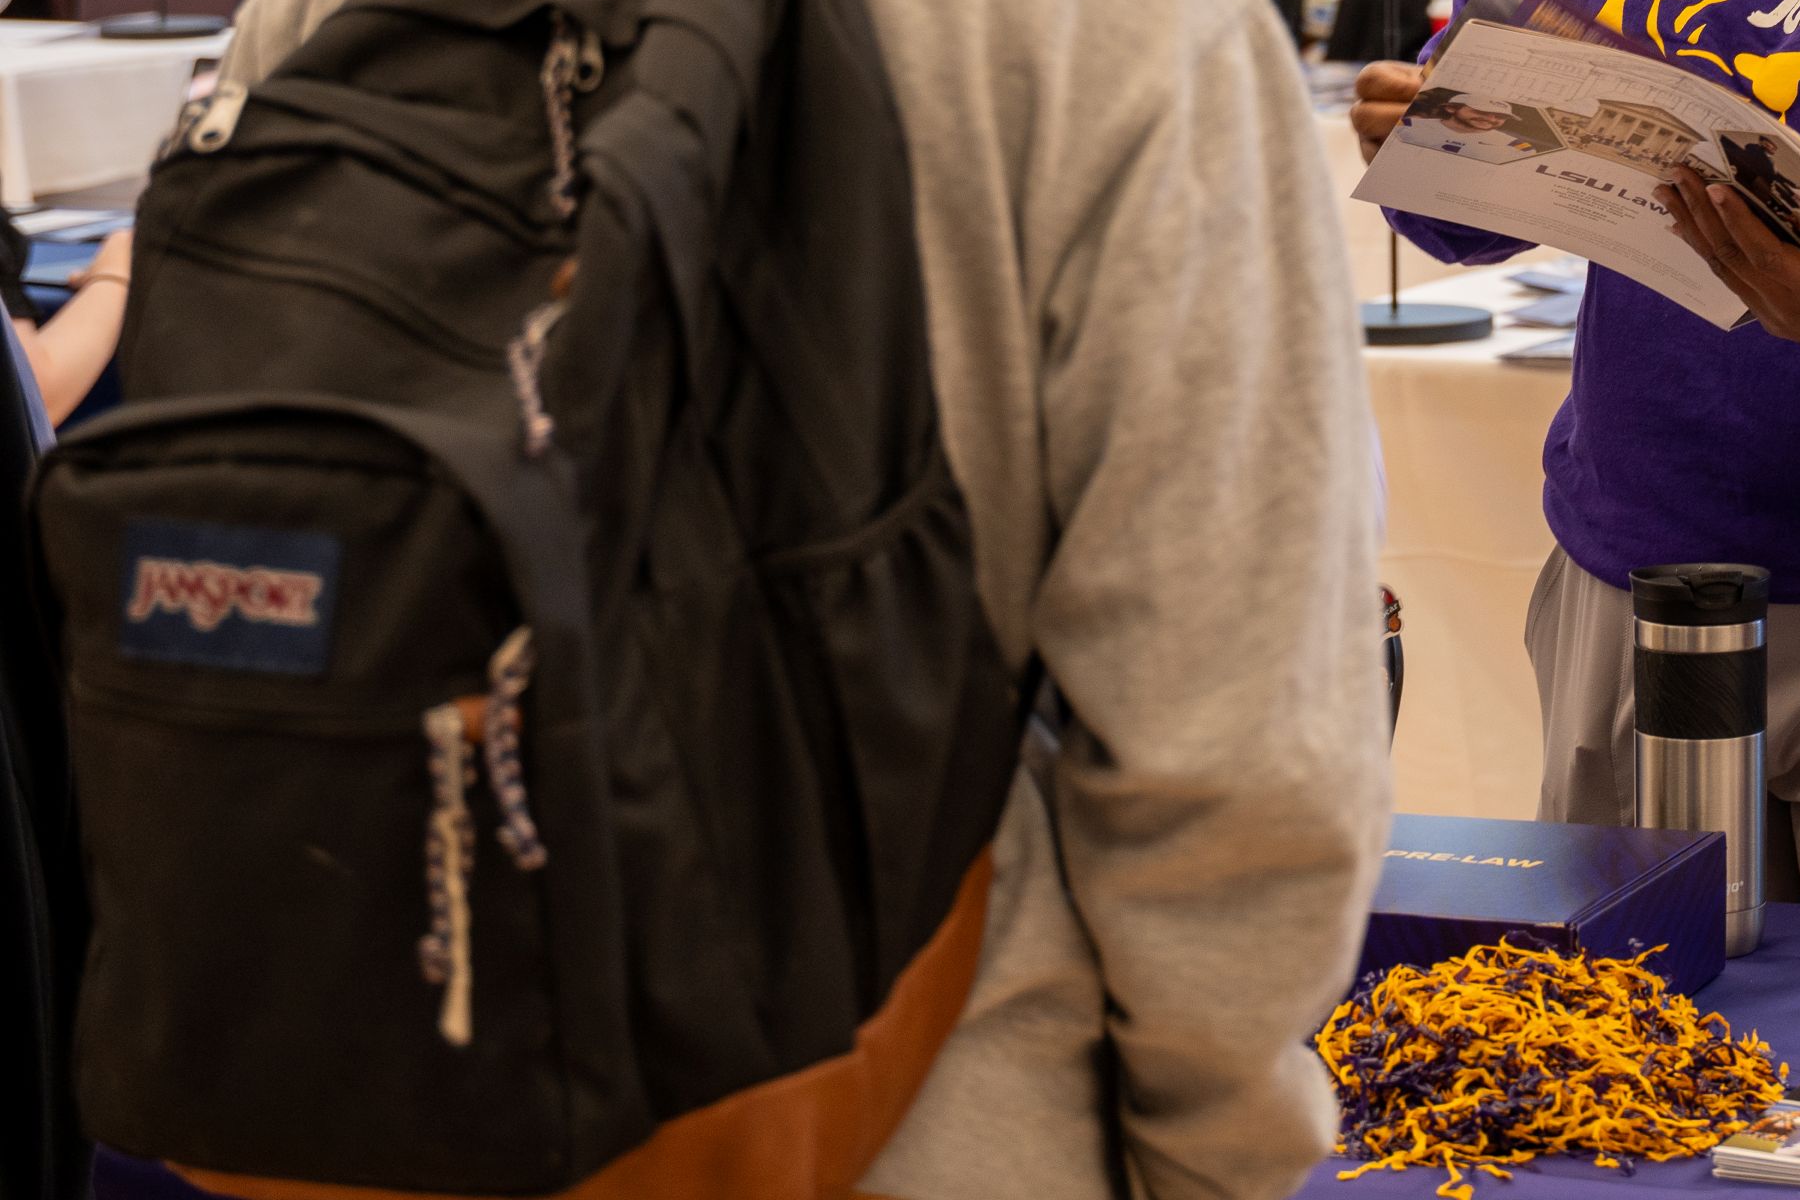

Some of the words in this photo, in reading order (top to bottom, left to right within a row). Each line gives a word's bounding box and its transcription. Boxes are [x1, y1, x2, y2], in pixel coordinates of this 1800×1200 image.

[1535, 164, 1614, 193] LSU
[1617, 188, 1671, 216] Law
[1381, 850, 1545, 869] PRE-LAW
